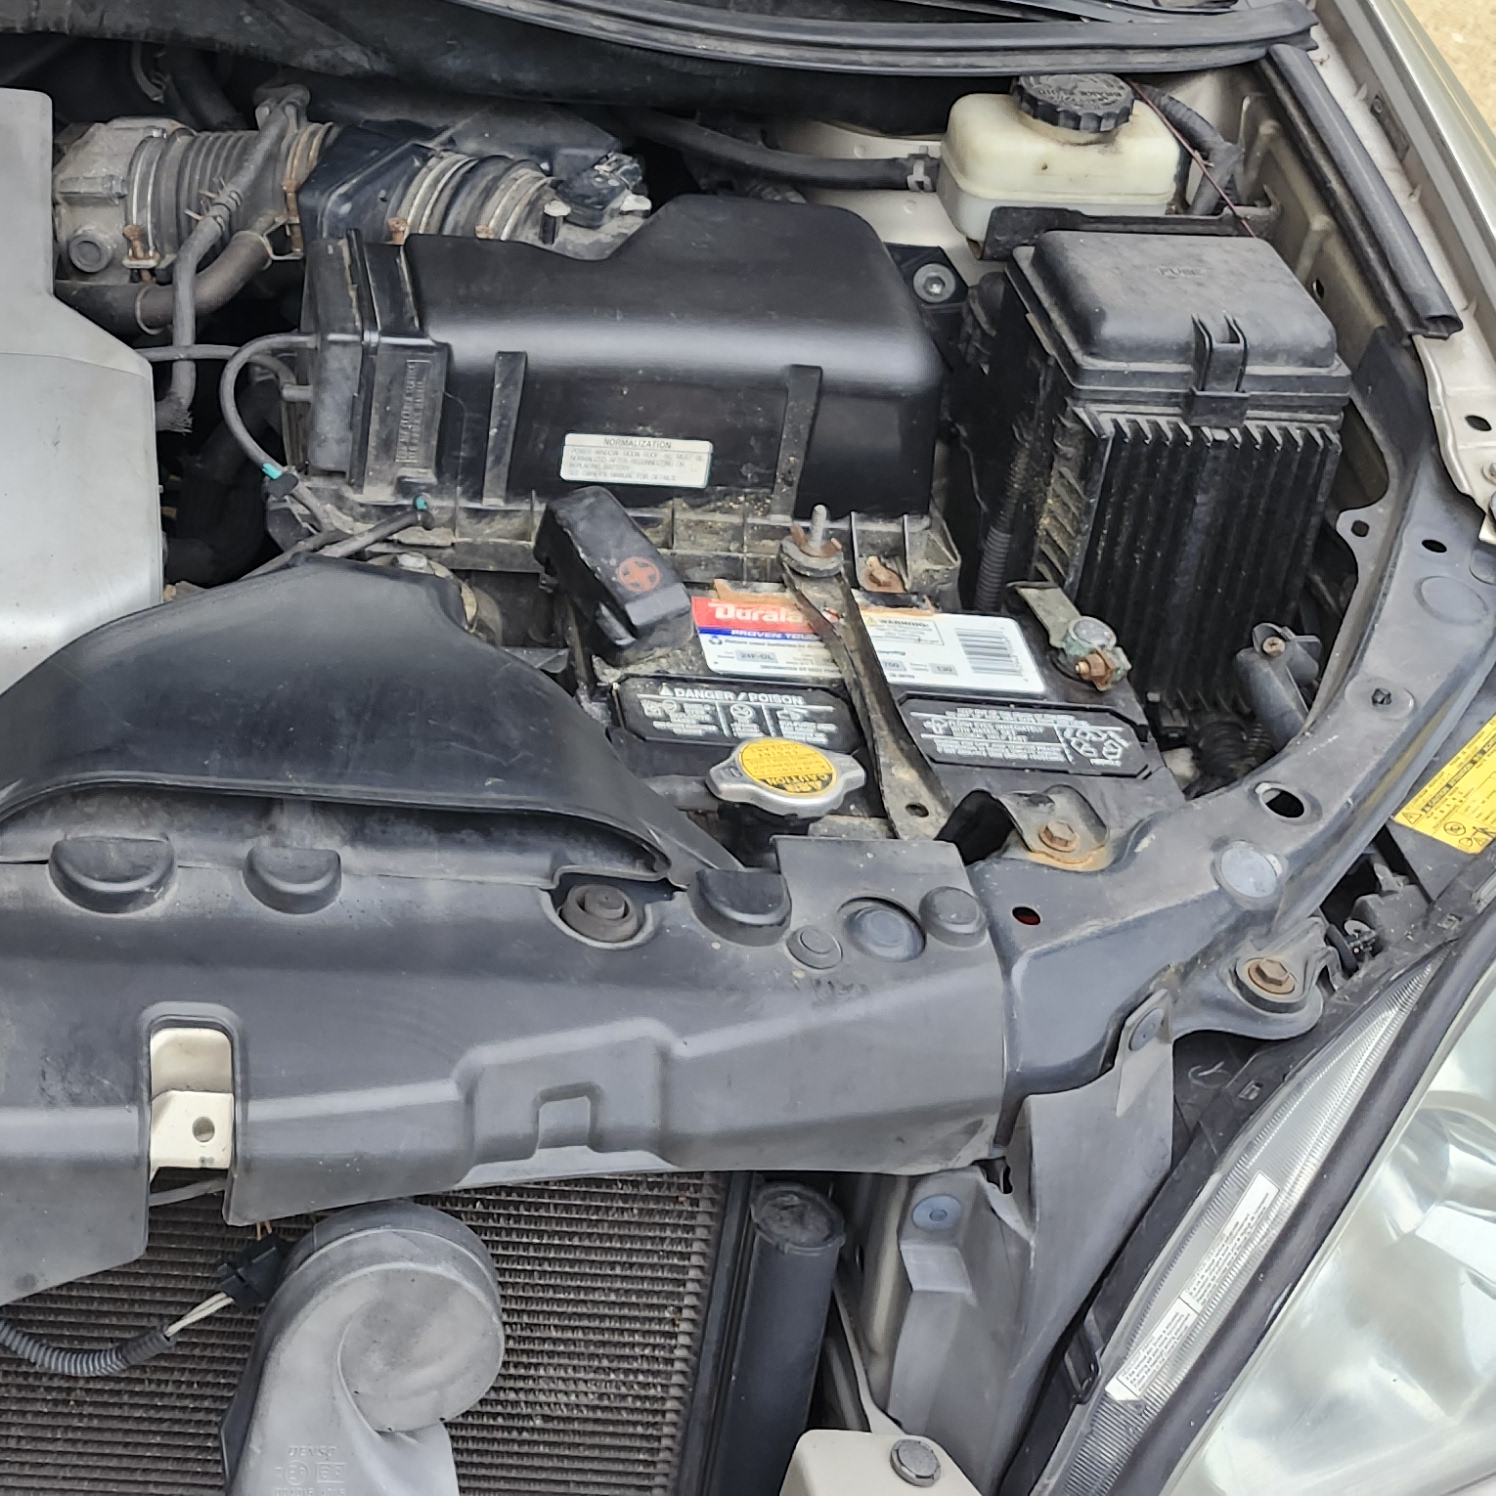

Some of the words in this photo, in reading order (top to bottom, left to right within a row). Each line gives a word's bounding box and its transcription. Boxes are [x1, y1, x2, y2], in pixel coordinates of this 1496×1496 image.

[603, 437, 672, 450] NORMALIZATION
[707, 602, 805, 622] Durala
[730, 629, 782, 639] PROVEN
[785, 631, 822, 642] TOU
[673, 687, 735, 701] DANGER
[748, 692, 805, 705] POISON
[766, 772, 829, 787] CAUTION
